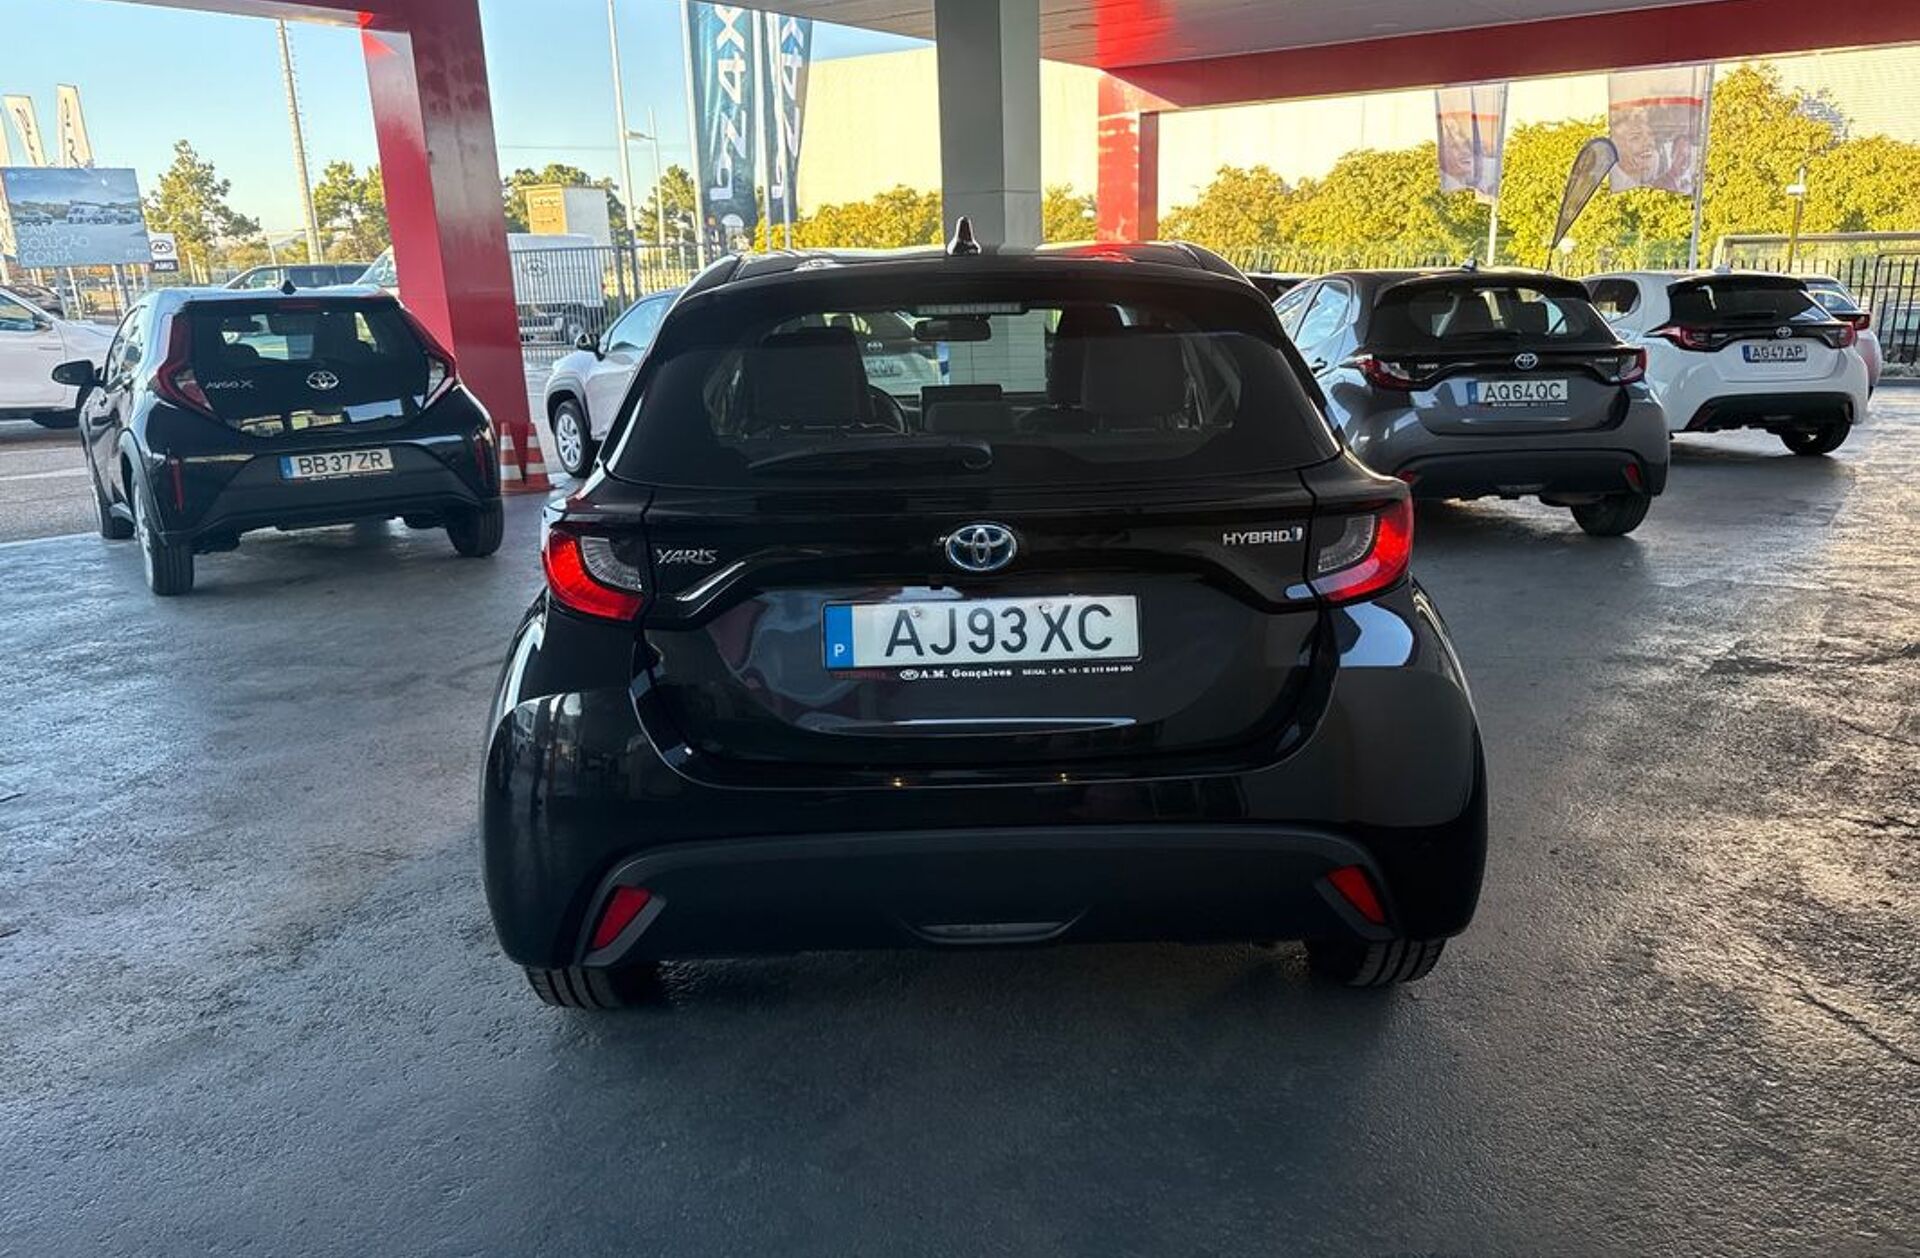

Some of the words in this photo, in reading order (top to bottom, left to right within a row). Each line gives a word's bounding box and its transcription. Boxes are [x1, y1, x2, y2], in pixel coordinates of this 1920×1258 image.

[1222, 529, 1290, 546] HYBRID
[656, 548, 718, 565] YARIS
[833, 643, 846, 658] P
[920, 668, 949, 679] A.M.
[952, 667, 1013, 679] Gonçalves
